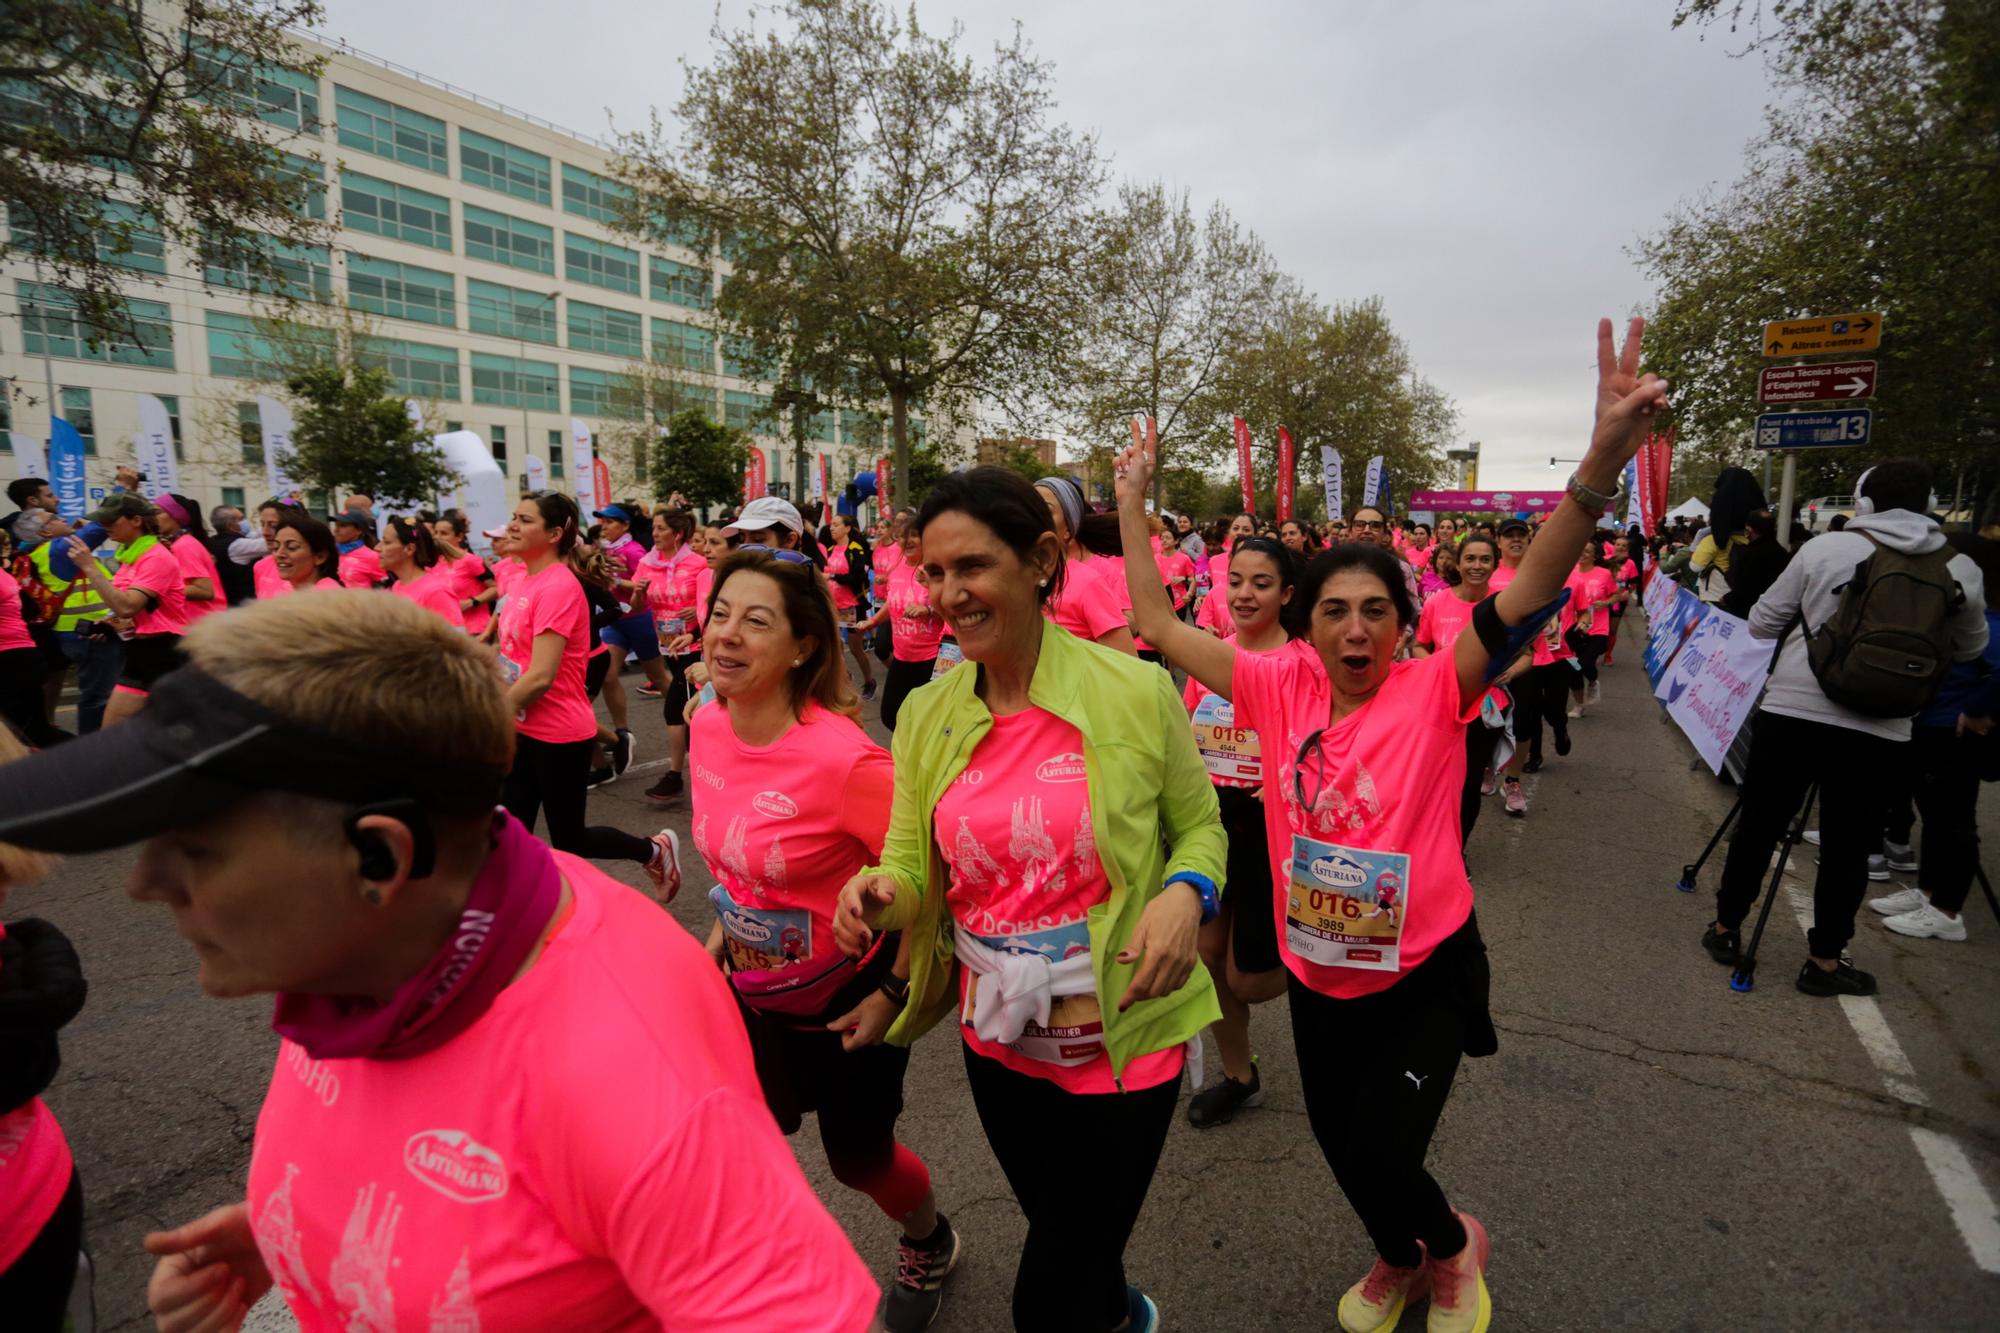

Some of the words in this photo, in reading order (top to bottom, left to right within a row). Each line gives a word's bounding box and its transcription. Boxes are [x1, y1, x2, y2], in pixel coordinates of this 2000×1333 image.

[1782, 324, 1825, 336] Rectoral
[1791, 338, 1822, 350] Altres
[1824, 337, 1865, 348] centres
[1766, 370, 1795, 380] Escola
[1834, 364, 1873, 376] Superior
[1761, 418, 1782, 426] Punt
[1783, 416, 1794, 426] de
[1796, 416, 1832, 425] trobada
[1836, 416, 1865, 440] 13
[1213, 726, 1246, 743] 016
[1314, 864, 1362, 883] ASTURIANA
[1309, 888, 1361, 919] 016
[1298, 922, 1321, 938] CARRERA
[1322, 931, 1332, 940] DE
[1333, 934, 1342, 942] LA
[1344, 936, 1370, 944] MUJER
[1317, 918, 1344, 932] 3989
[728, 936, 770, 969] 016
[1040, 1028, 1050, 1037] LA
[1052, 1028, 1082, 1038] MUJER
[410, 1142, 502, 1192] ASTURIANA
